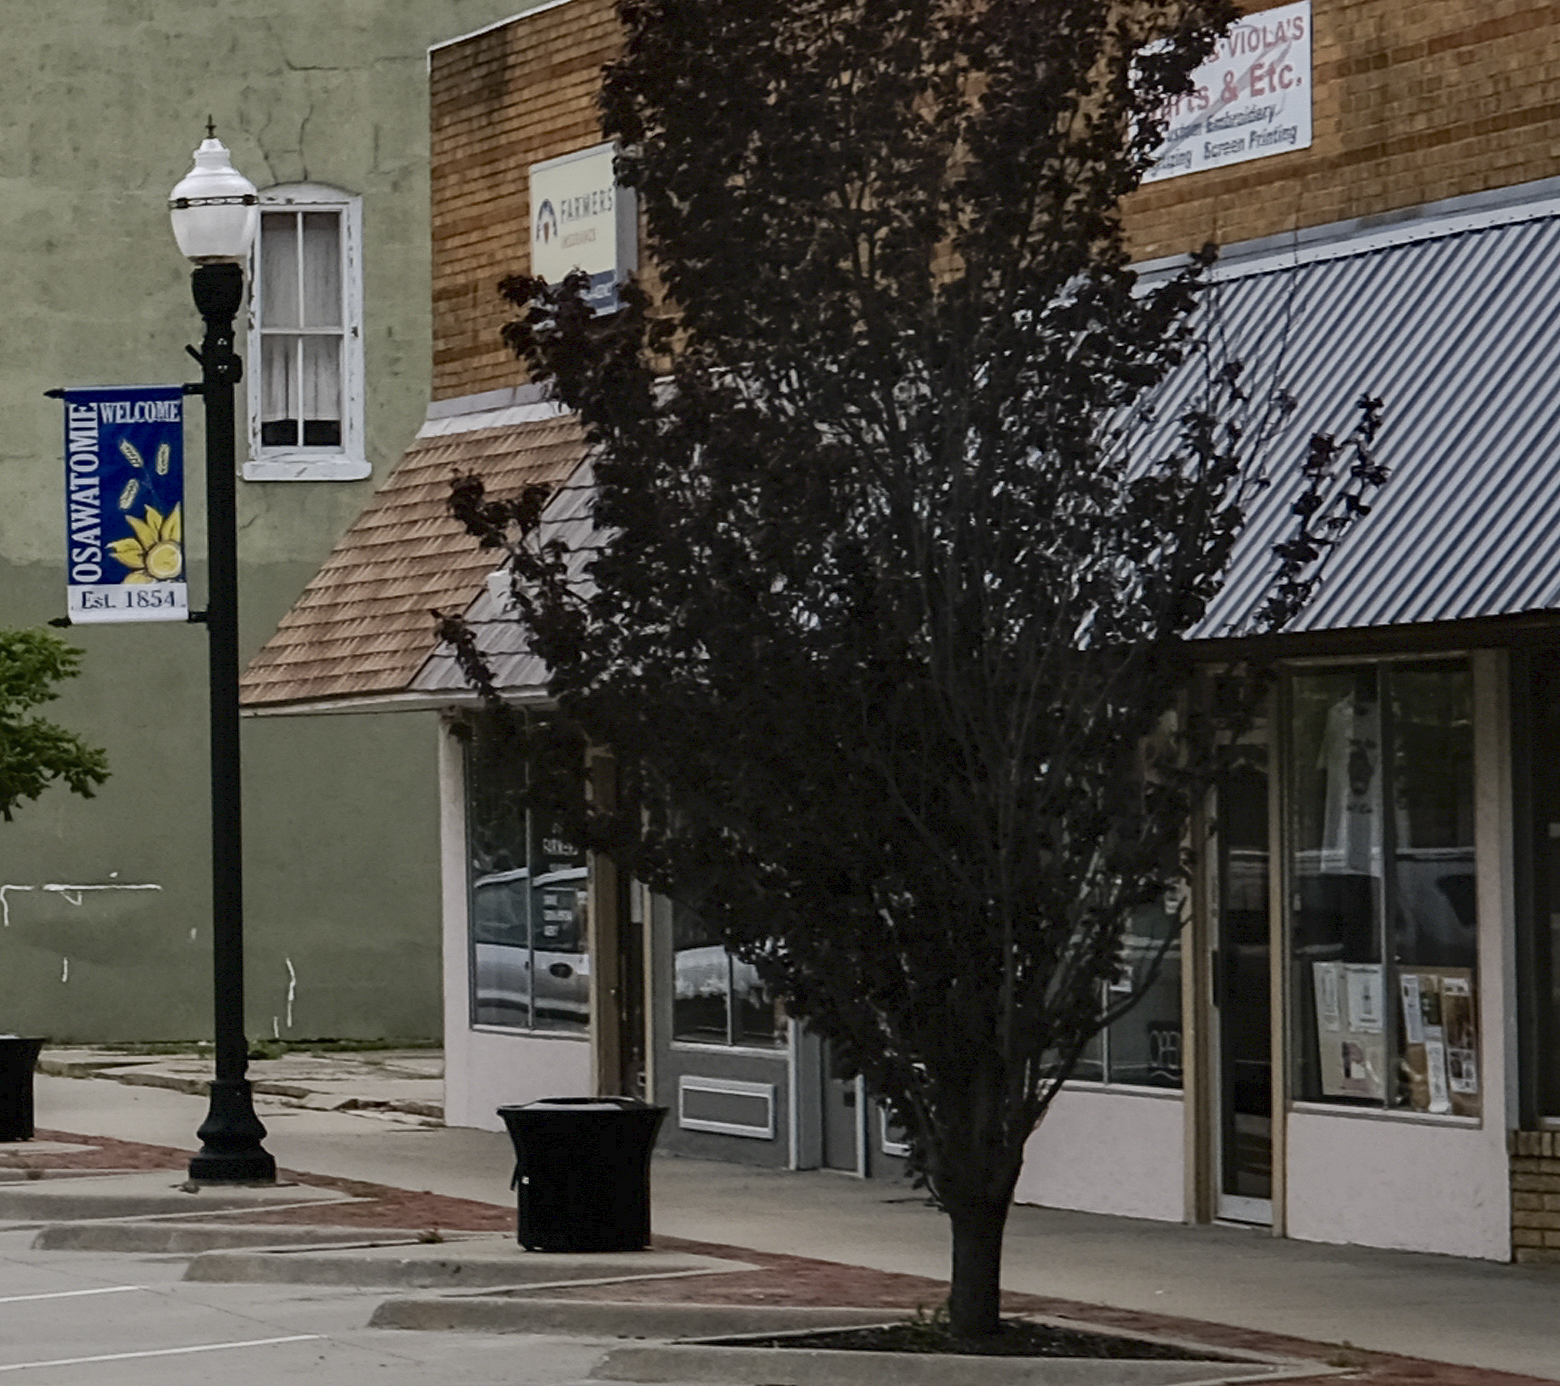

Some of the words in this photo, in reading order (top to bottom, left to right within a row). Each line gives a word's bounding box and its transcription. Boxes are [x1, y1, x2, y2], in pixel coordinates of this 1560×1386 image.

[1228, 16, 1305, 57] VIOLA'S
[1220, 70, 1239, 104] &
[1250, 62, 1302, 98] Etc.
[1204, 137, 1246, 160] Screen
[1249, 124, 1298, 150] Printing
[560, 188, 613, 224] FARMERS
[100, 401, 181, 424] WELCOME
[70, 403, 102, 583] OSAWATOMIE
[81, 590, 117, 610] Est.
[125, 591, 175, 609] 1854
